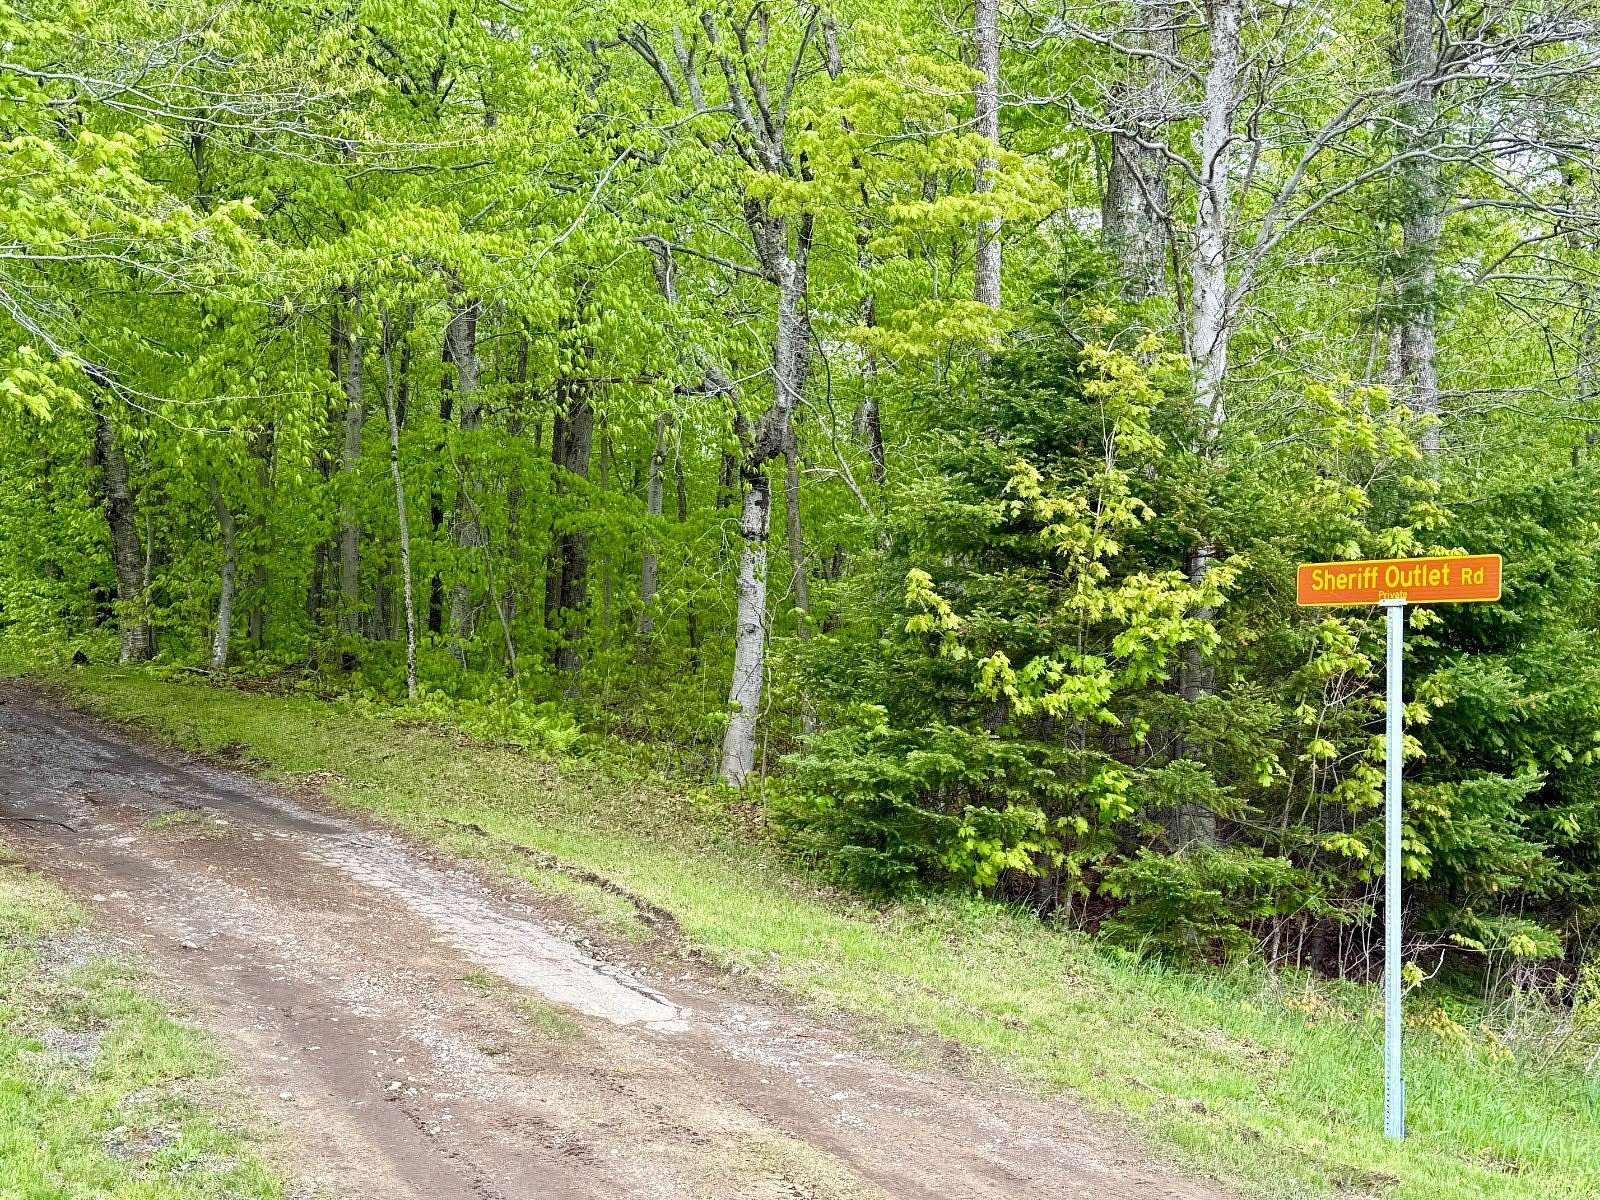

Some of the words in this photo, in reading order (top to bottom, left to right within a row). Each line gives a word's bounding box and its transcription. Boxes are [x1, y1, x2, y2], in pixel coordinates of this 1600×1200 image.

[1311, 566, 1379, 591] Sheriff
[1385, 563, 1450, 588] Outlet
[1461, 567, 1484, 585] Rd
[1378, 590, 1408, 600] Private
